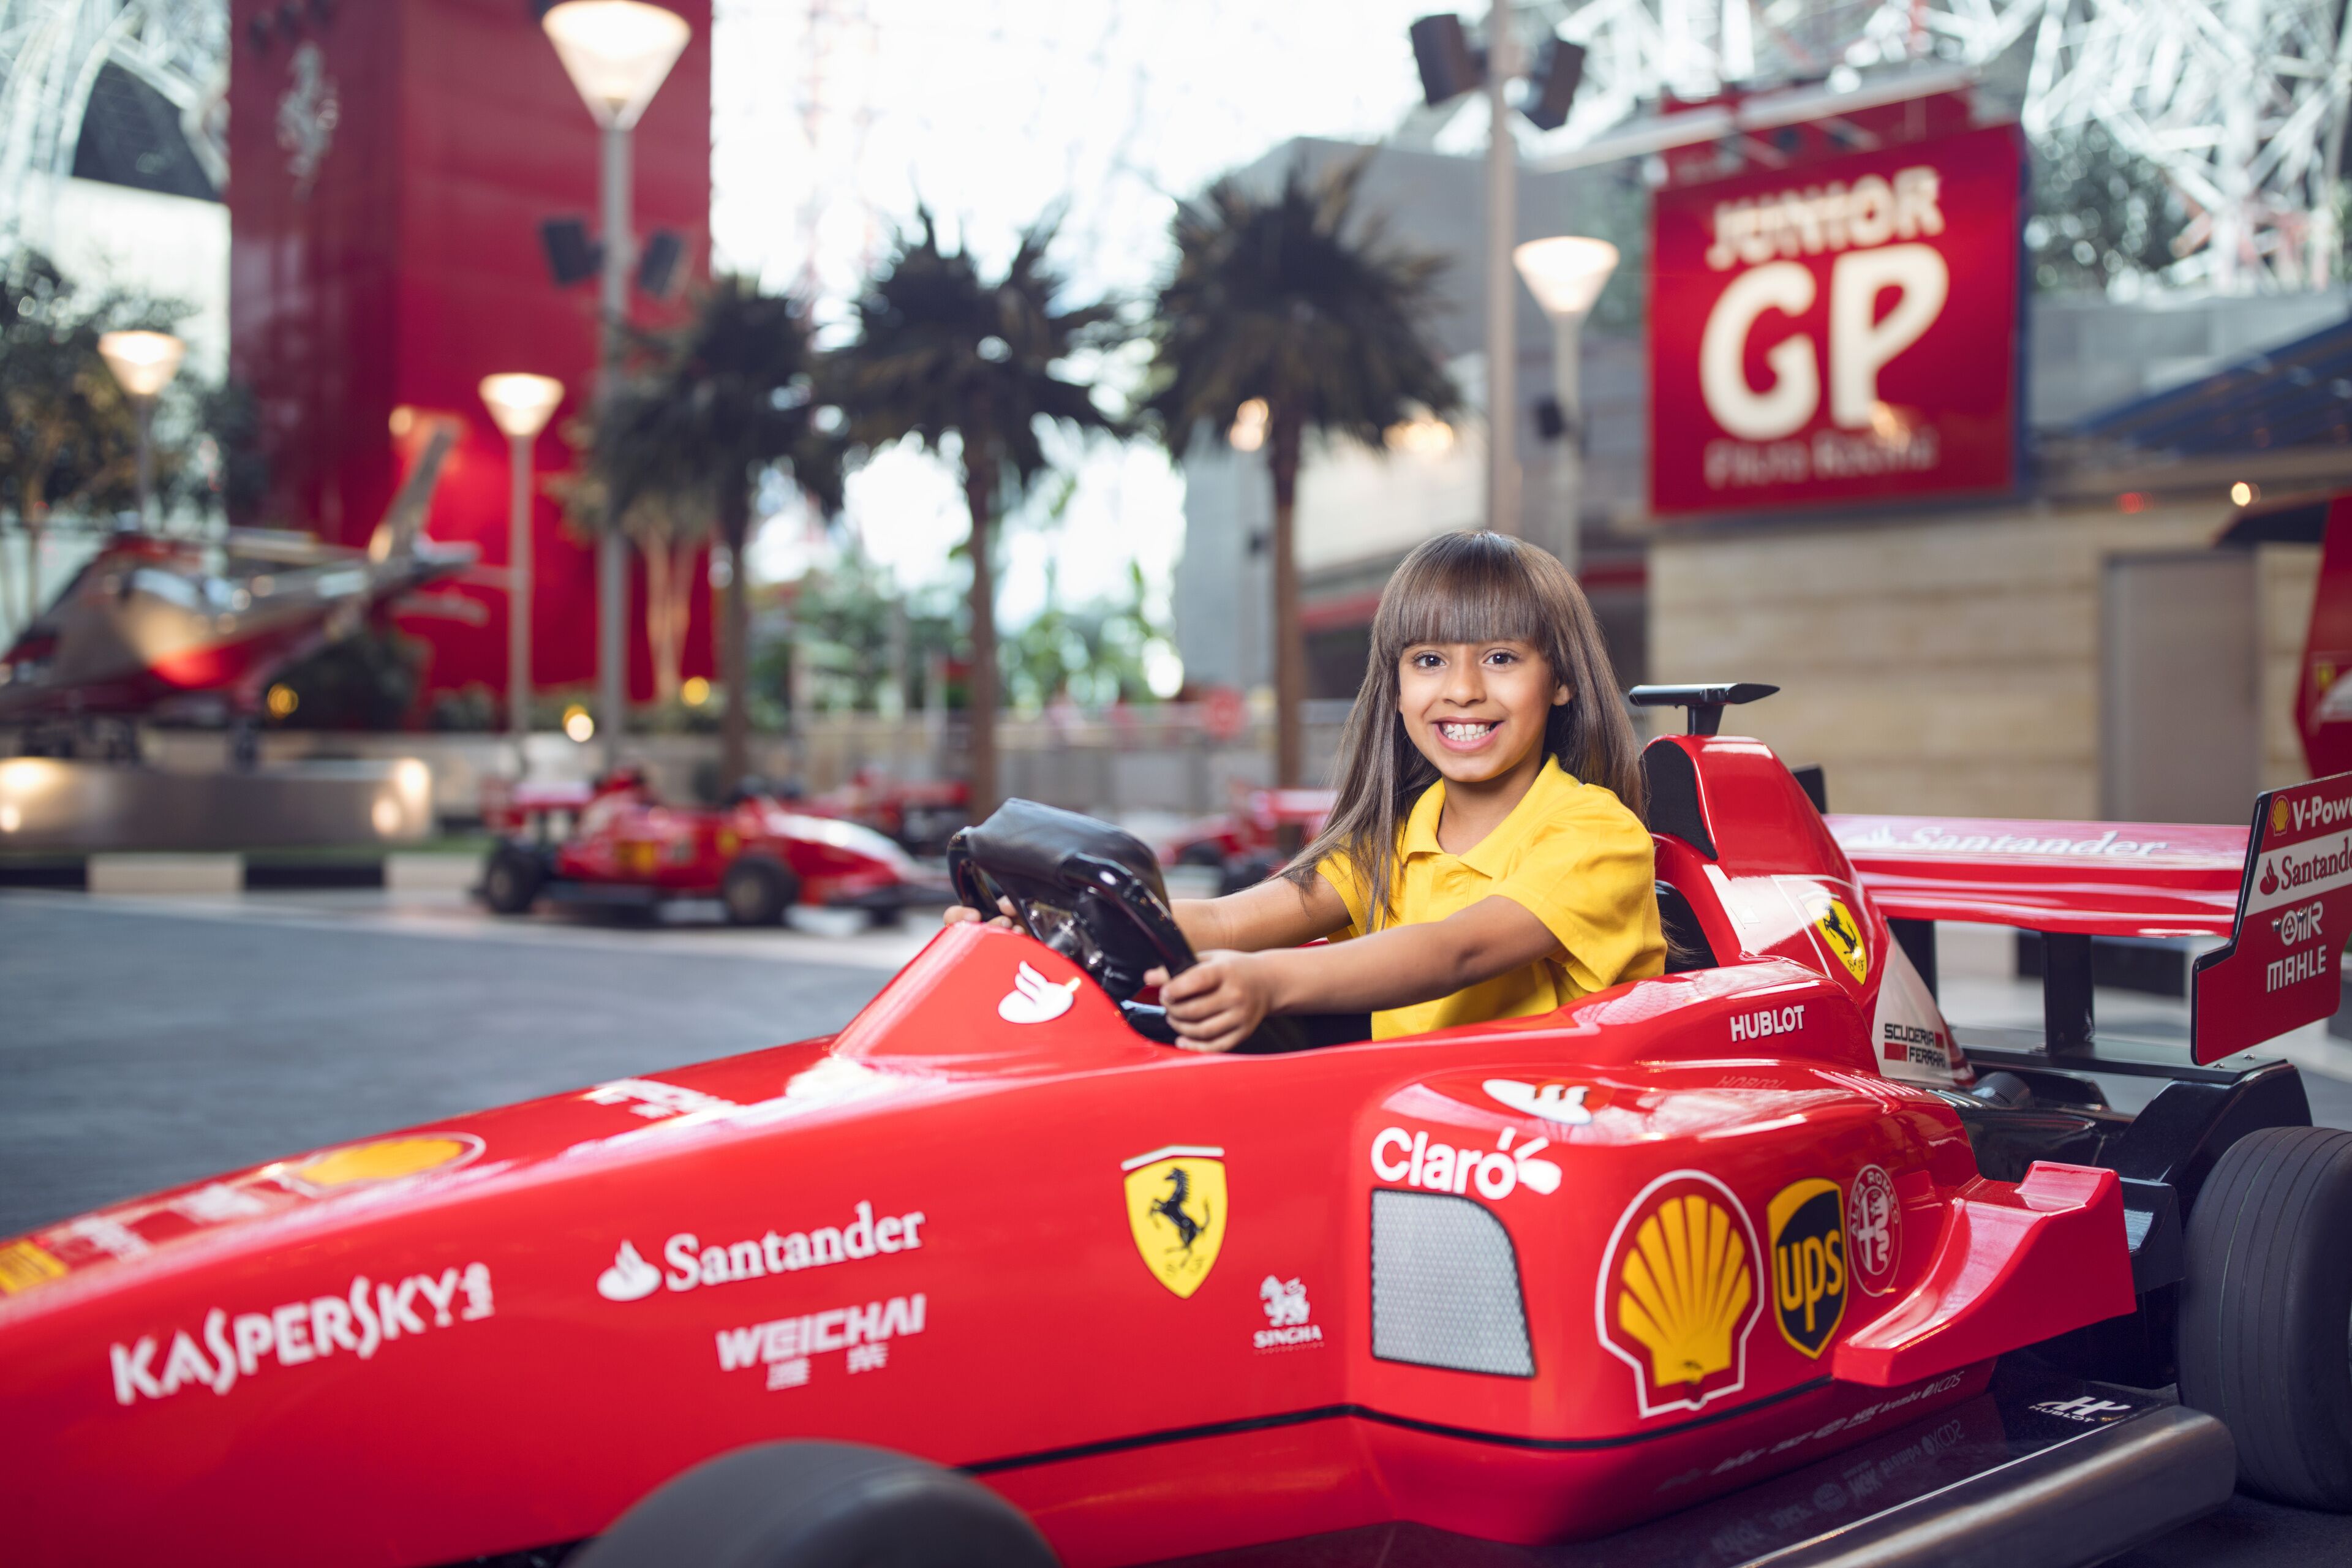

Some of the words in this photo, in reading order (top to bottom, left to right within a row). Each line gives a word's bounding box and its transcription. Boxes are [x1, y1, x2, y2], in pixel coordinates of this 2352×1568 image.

[1706, 165, 1944, 270] JUNIOR
[1699, 242, 1950, 440] GP
[2293, 795, 2352, 831] V-Pow
[1901, 827, 2168, 856] Santander
[2267, 944, 2326, 992] MAHLE
[1730, 1005, 1804, 1042] HUBLOT
[1884, 1023, 1934, 1046] SCUDERIA
[1909, 1046, 1946, 1068] FERRARI
[664, 1199, 926, 1292] Santander
[1779, 1229, 1844, 1332] ups
[110, 1267, 460, 1406] KASPERSKY
[715, 1292, 927, 1372] WEICHAI
[2028, 1405, 2095, 1423] HUBLOT
